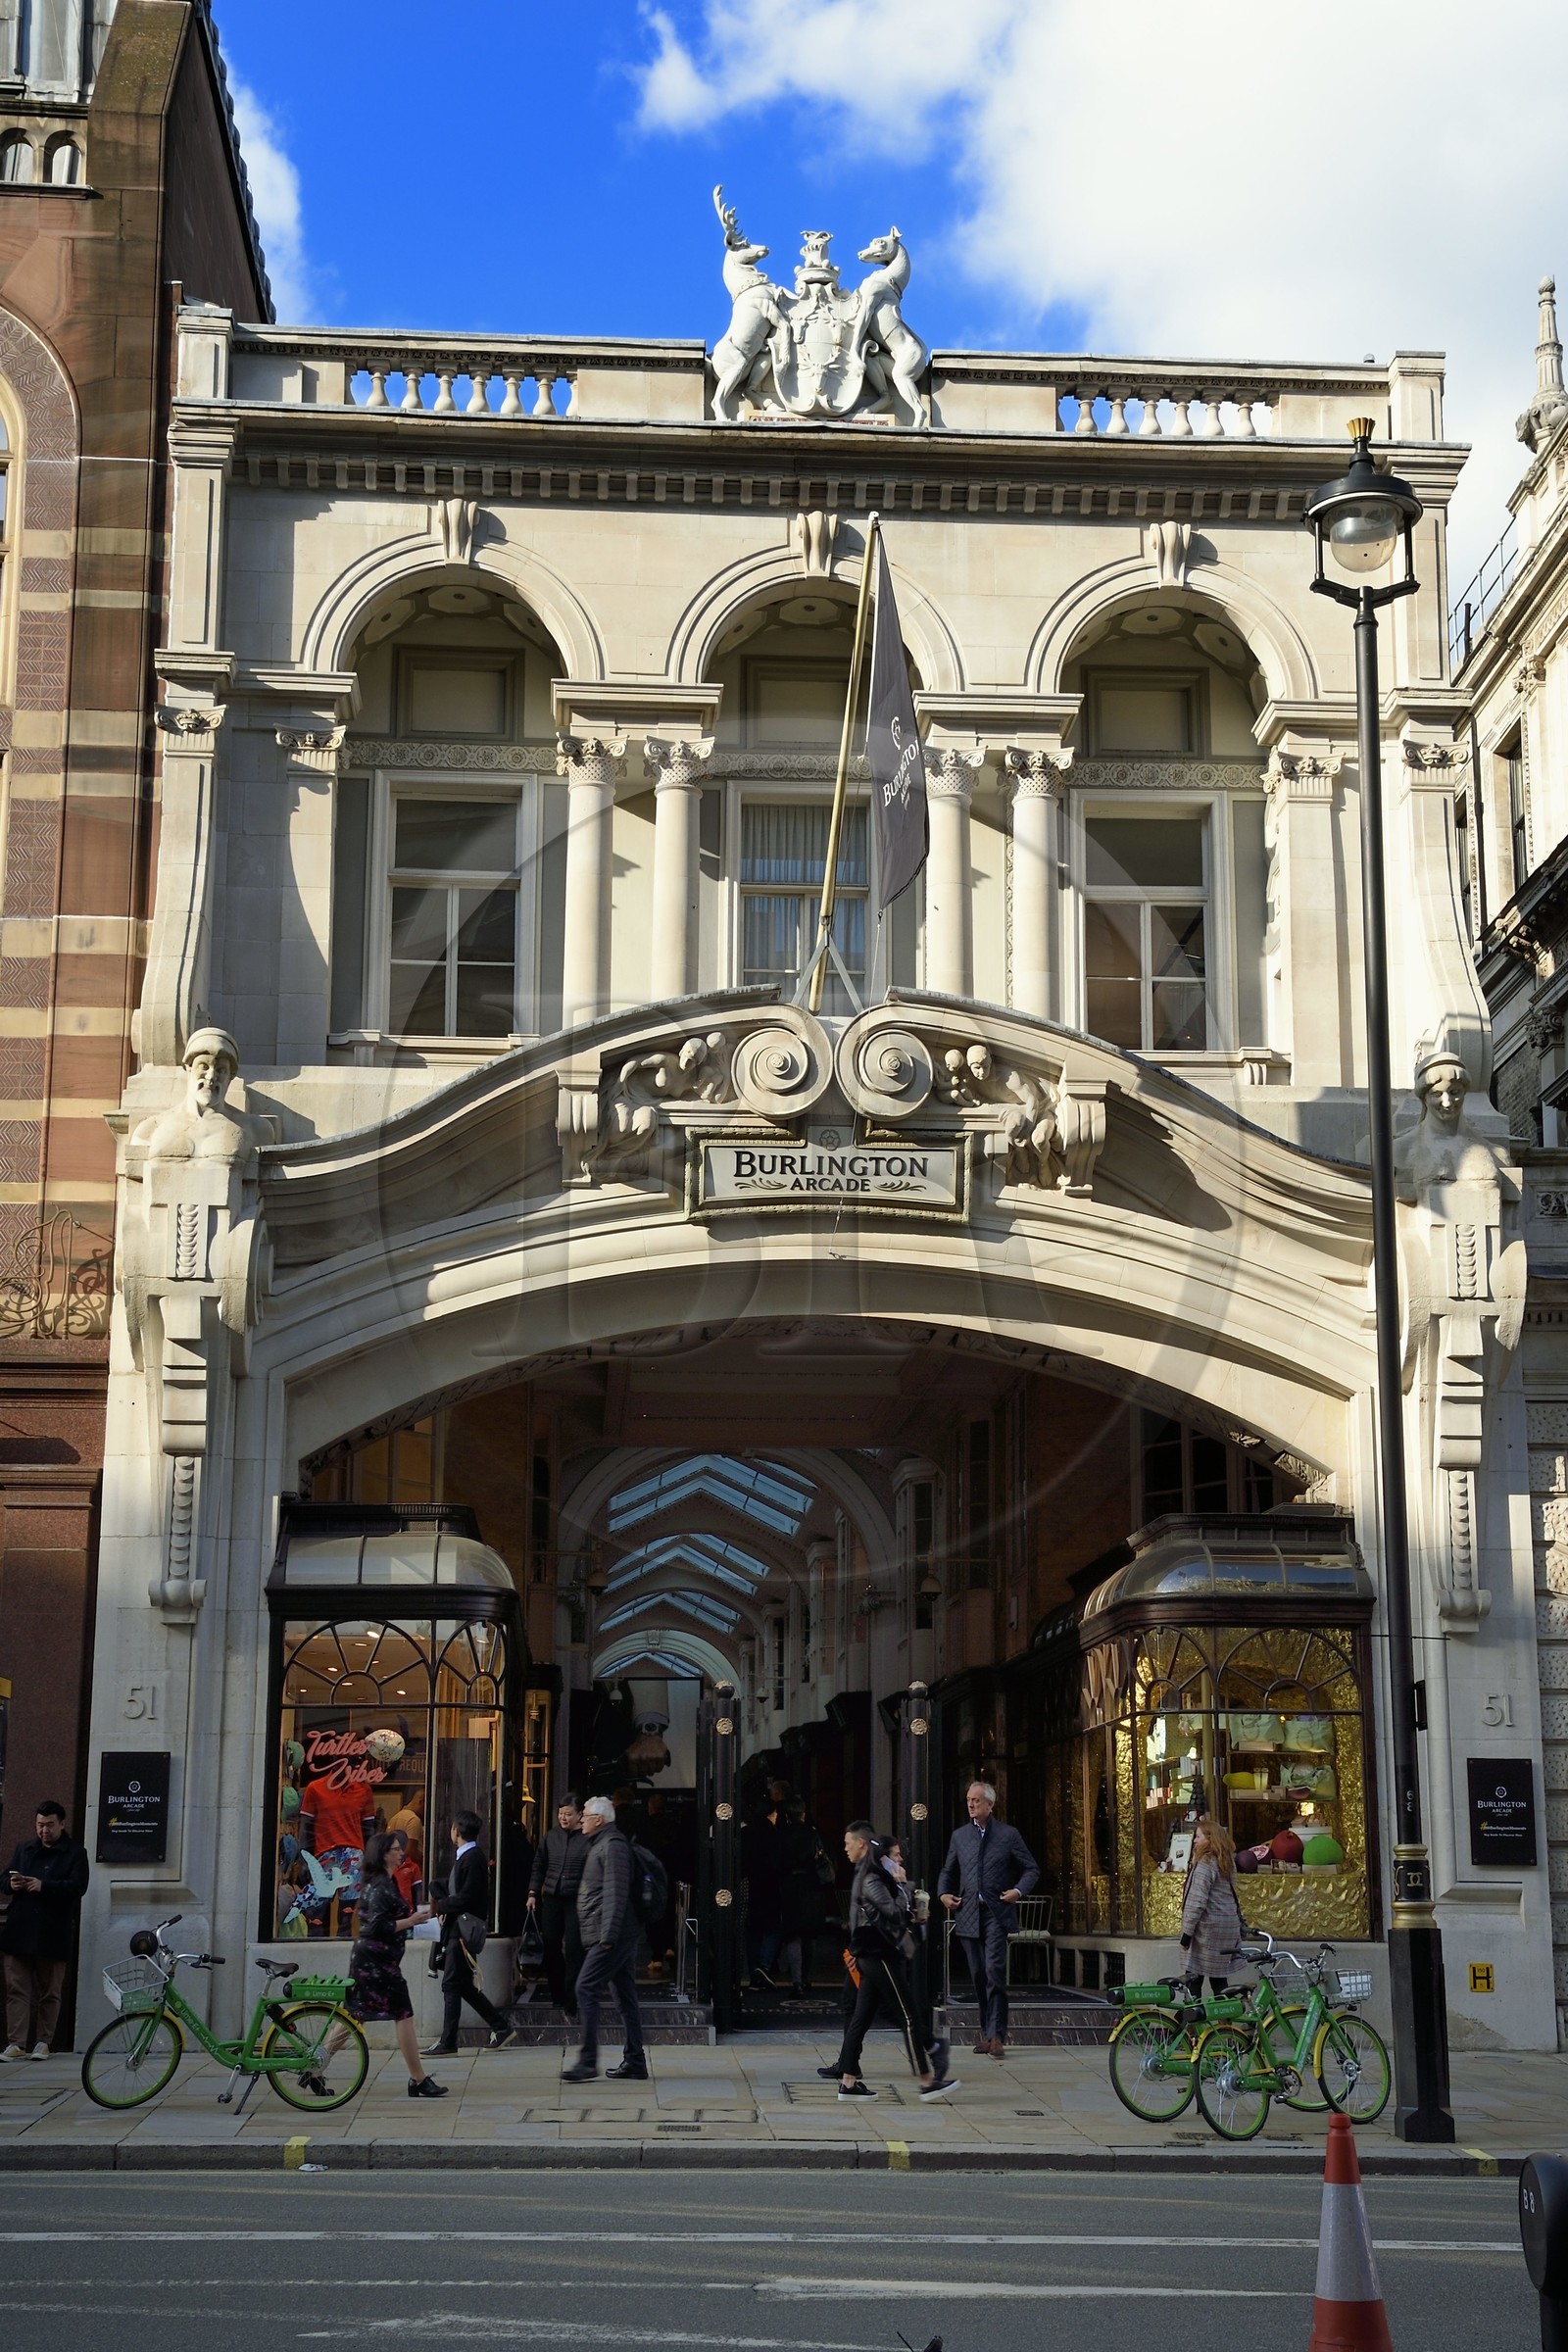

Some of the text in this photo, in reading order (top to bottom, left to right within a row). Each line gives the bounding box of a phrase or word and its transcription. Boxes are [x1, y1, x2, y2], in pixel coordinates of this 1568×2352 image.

[733, 1151, 929, 1178] BURLINGTON
[790, 1177, 871, 1192] ARCADE
[123, 1686, 157, 1720] 51
[1481, 1693, 1514, 1727] 51
[306, 1730, 370, 1762] Turtles
[310, 1757, 388, 1790] Vibes
[108, 1795, 161, 1804] BURLINGTON
[1477, 1800, 1527, 1809] BURLINGTON
[1472, 1966, 1491, 1989] H
